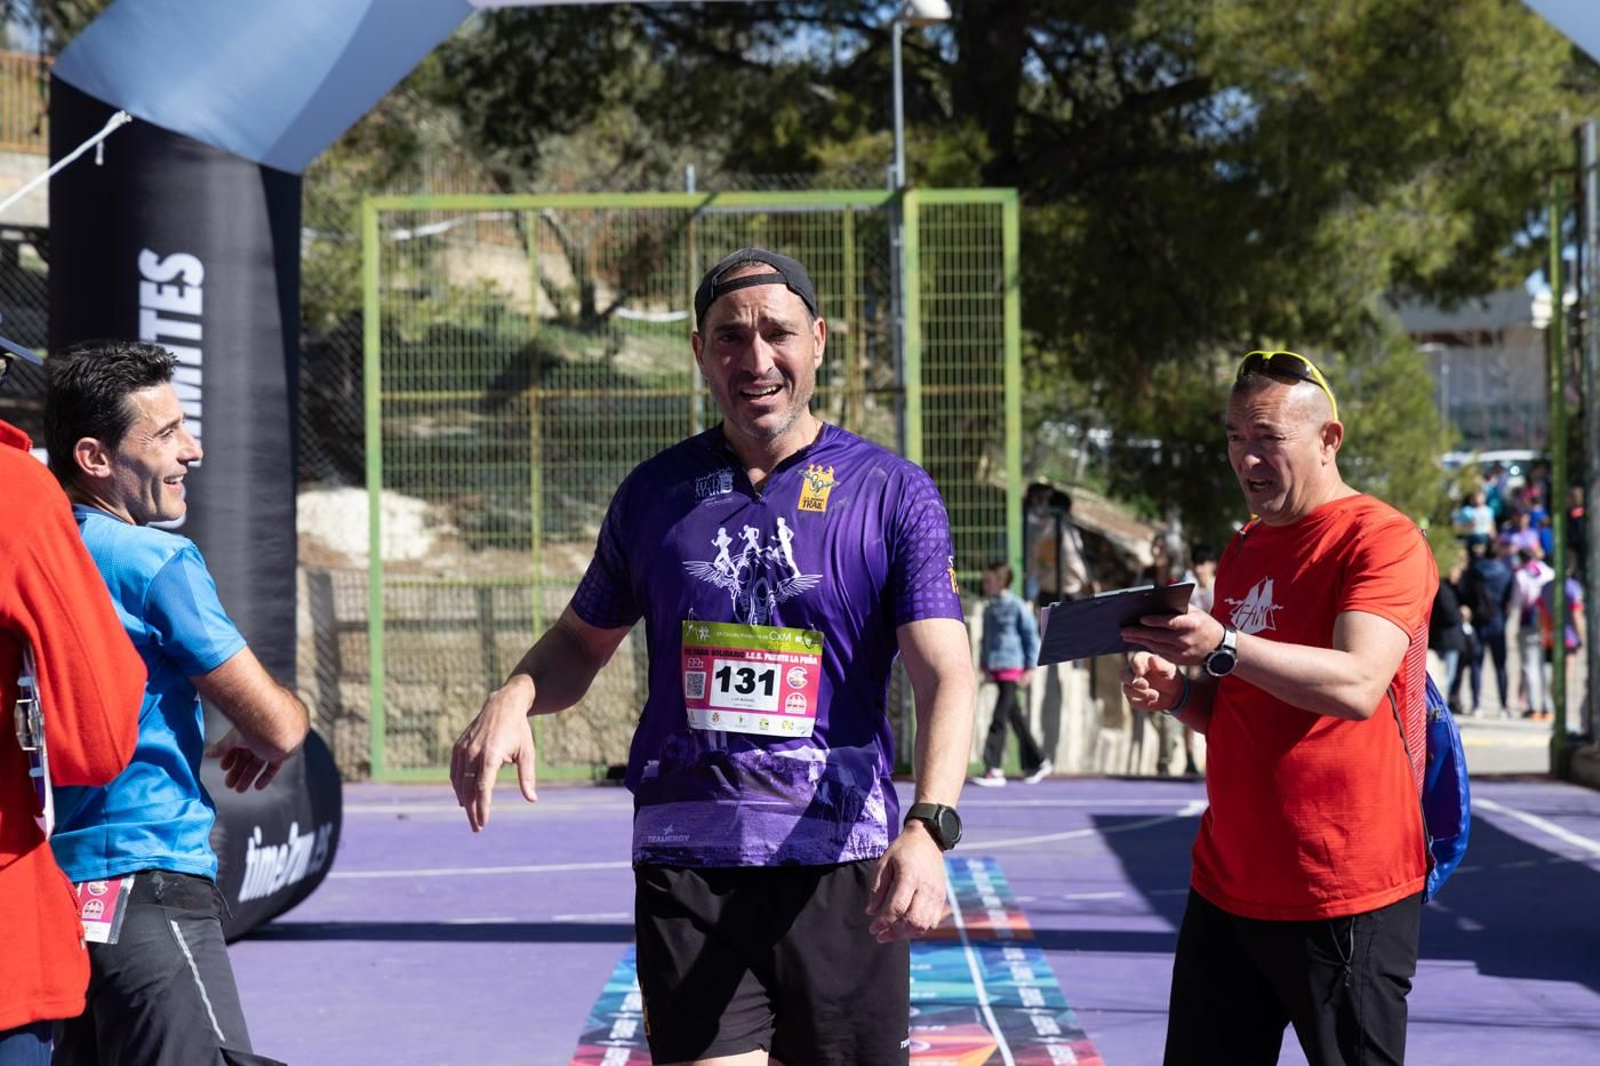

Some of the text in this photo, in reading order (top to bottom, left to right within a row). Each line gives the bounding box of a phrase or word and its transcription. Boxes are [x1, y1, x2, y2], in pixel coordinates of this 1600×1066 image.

[768, 630, 792, 641] CxM
[711, 649, 745, 658] SOLIDARIO
[715, 665, 775, 697] 131
